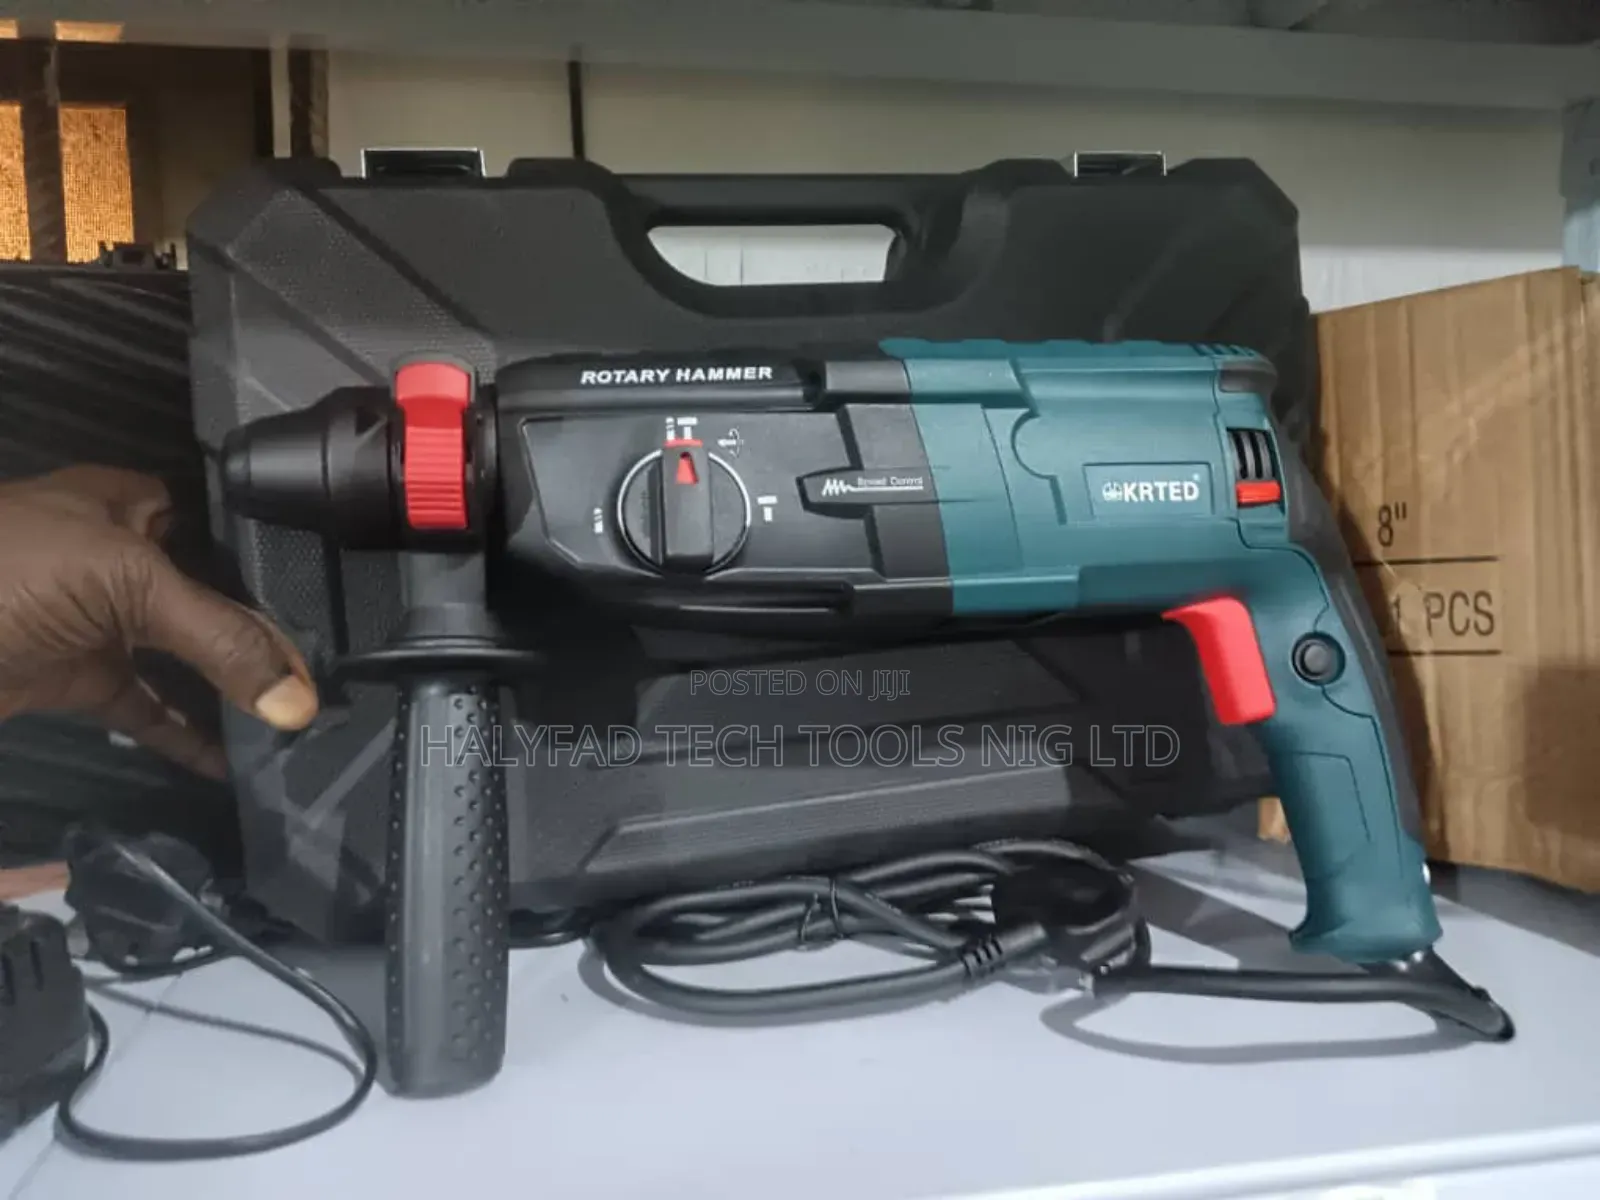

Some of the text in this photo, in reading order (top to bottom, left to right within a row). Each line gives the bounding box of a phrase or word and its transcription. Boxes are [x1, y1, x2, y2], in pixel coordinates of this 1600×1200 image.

[580, 366, 774, 385] ROTARY HAMMER
[1123, 480, 1200, 502] KRTED
[1423, 590, 1495, 637] PCS
